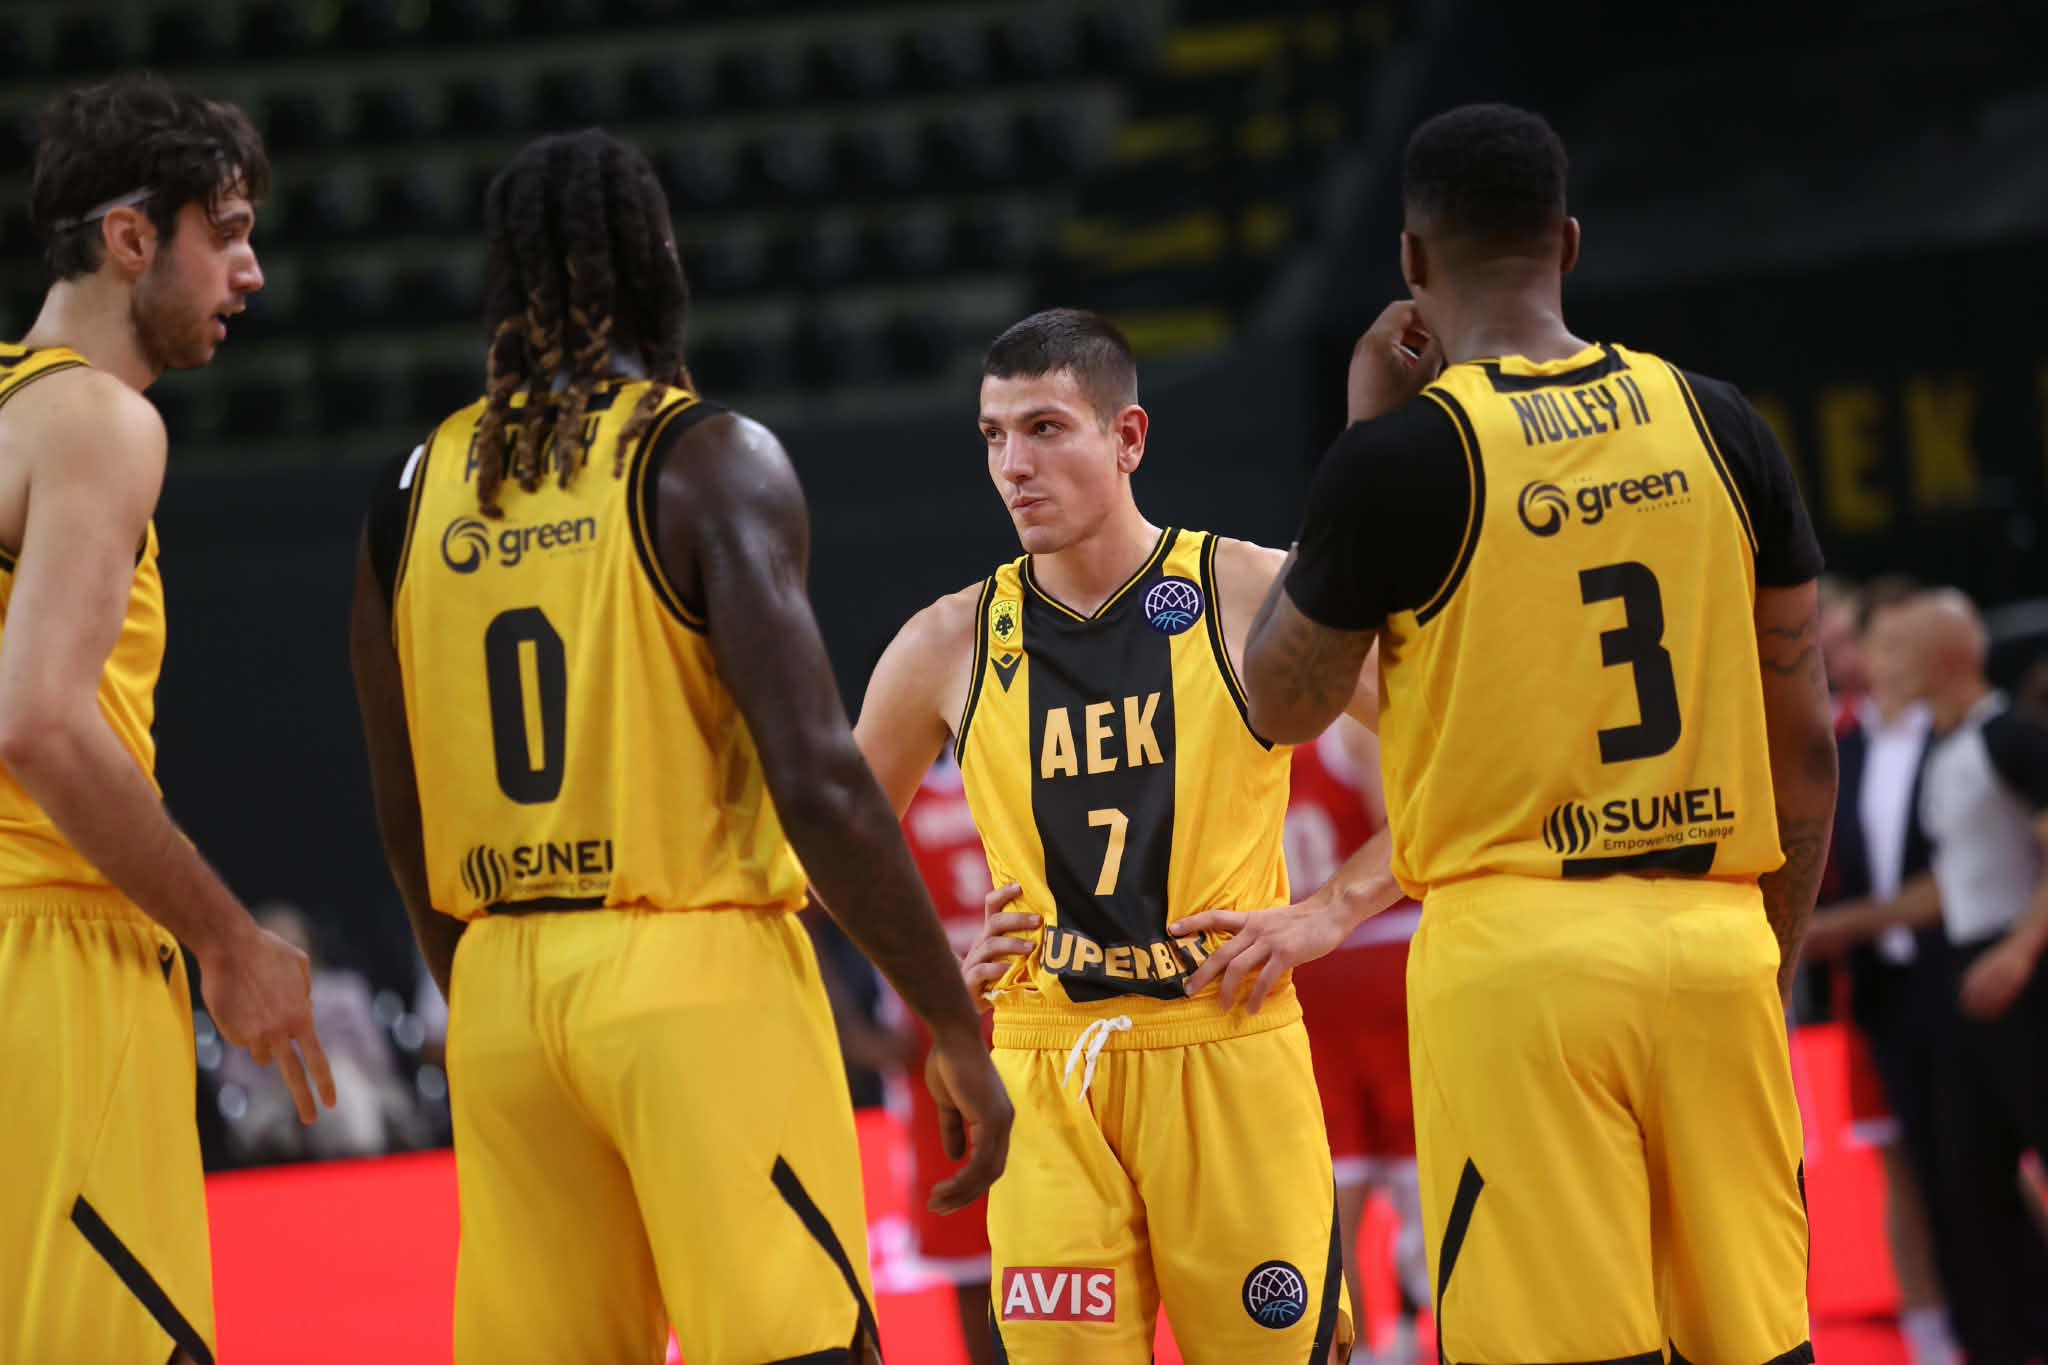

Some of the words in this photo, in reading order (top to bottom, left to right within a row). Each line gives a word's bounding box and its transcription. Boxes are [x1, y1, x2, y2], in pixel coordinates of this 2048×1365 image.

[1508, 383, 1620, 446] NOLLEY
[1615, 375, 1652, 426] II
[1576, 468, 1689, 525] green
[498, 516, 596, 568] green
[1578, 560, 1682, 765] 3
[484, 605, 567, 805] 0
[1040, 692, 1164, 779] AEK
[1602, 786, 1736, 834] SUNEL
[1687, 824, 1736, 841] Change
[1087, 807, 1130, 896] 7
[1003, 1272, 1114, 1317] AVIS
